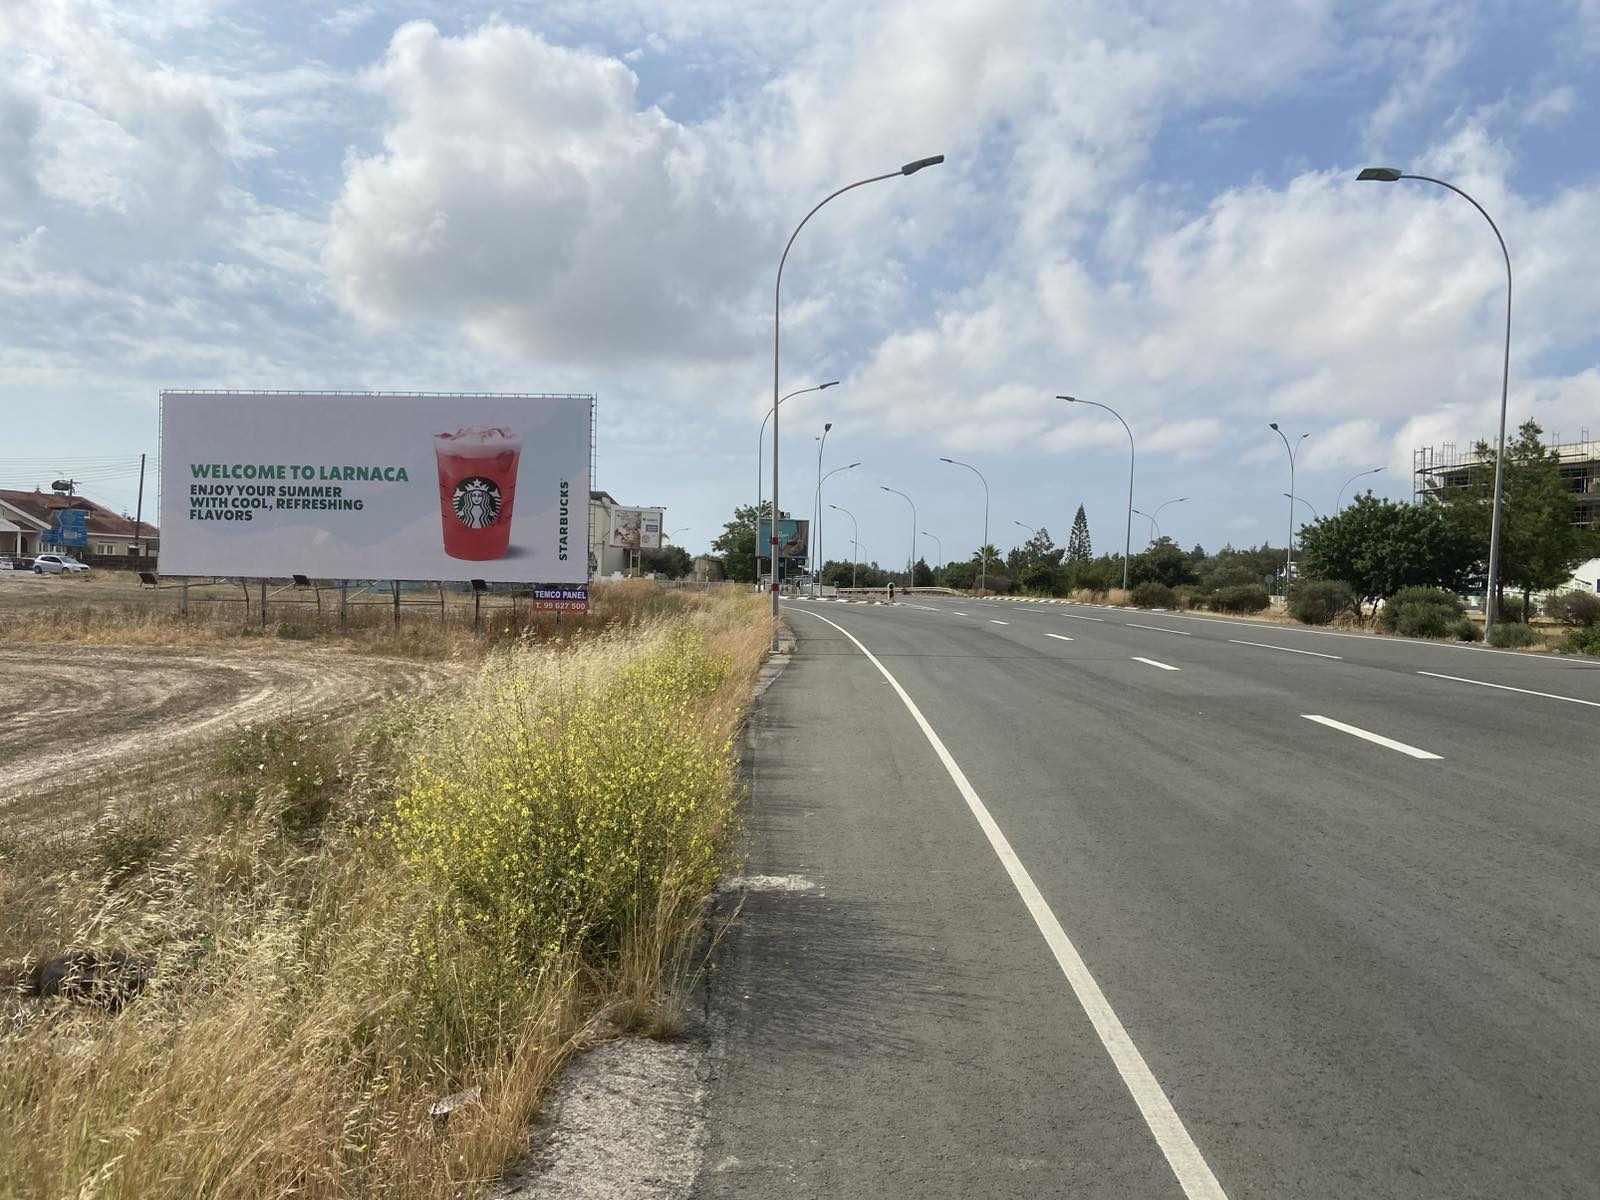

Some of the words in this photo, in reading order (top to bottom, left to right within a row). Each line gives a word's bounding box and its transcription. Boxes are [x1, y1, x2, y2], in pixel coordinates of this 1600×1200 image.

[190, 464, 286, 480] WELCOME
[290, 465, 316, 480] TO
[320, 466, 409, 482] LARNACA
[190, 484, 234, 496] ENJOY
[236, 485, 276, 497] YOUR
[278, 486, 342, 498] SUMMER
[190, 497, 228, 509] WITH
[231, 497, 273, 512] COOL,
[276, 498, 364, 511] REFRESHING
[190, 509, 253, 521] FLAVORS
[559, 481, 569, 561] STARBUCKS
[534, 590, 561, 599] TEMCO
[562, 591, 587, 600] PANEL
[571, 602, 586, 610] 500
